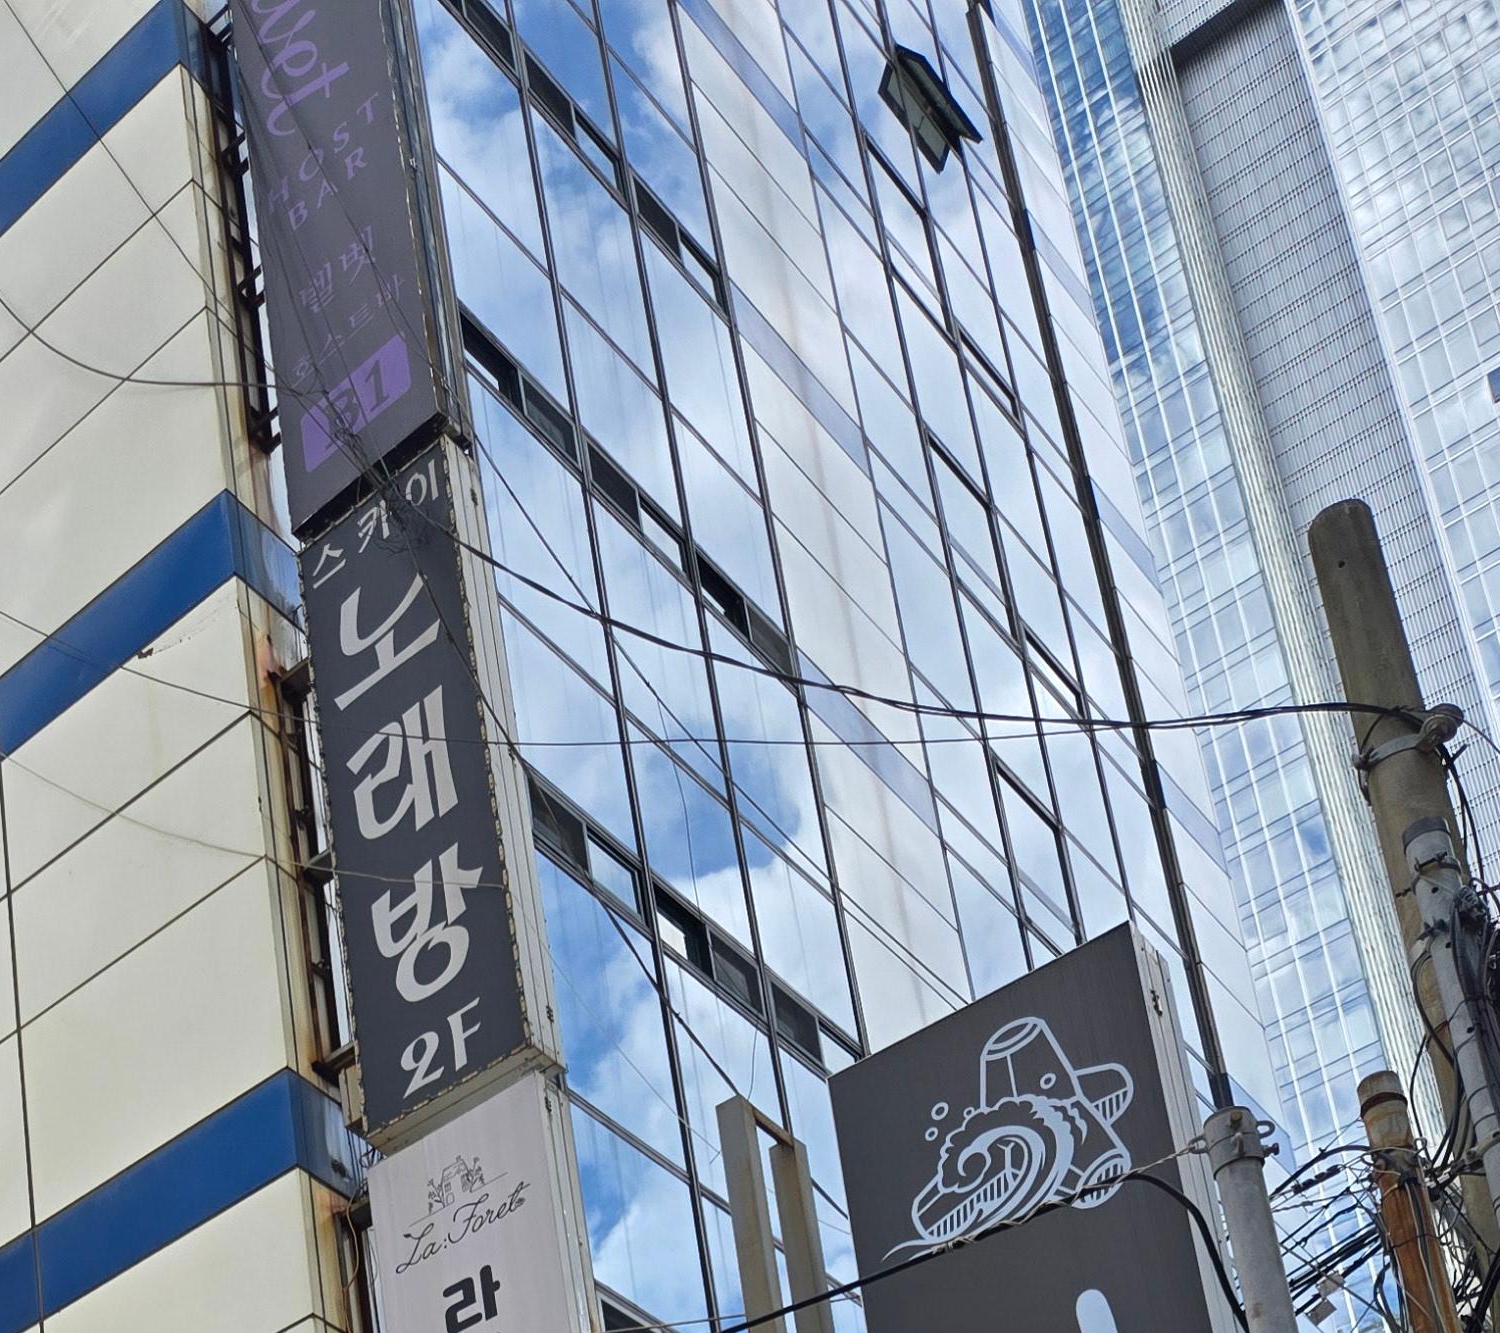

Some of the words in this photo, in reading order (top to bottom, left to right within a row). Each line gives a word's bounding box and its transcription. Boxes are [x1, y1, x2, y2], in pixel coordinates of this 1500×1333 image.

[288, 147, 367, 231] BAR
[334, 573, 483, 1002] 노래방
[400, 997, 481, 1098] 2F
